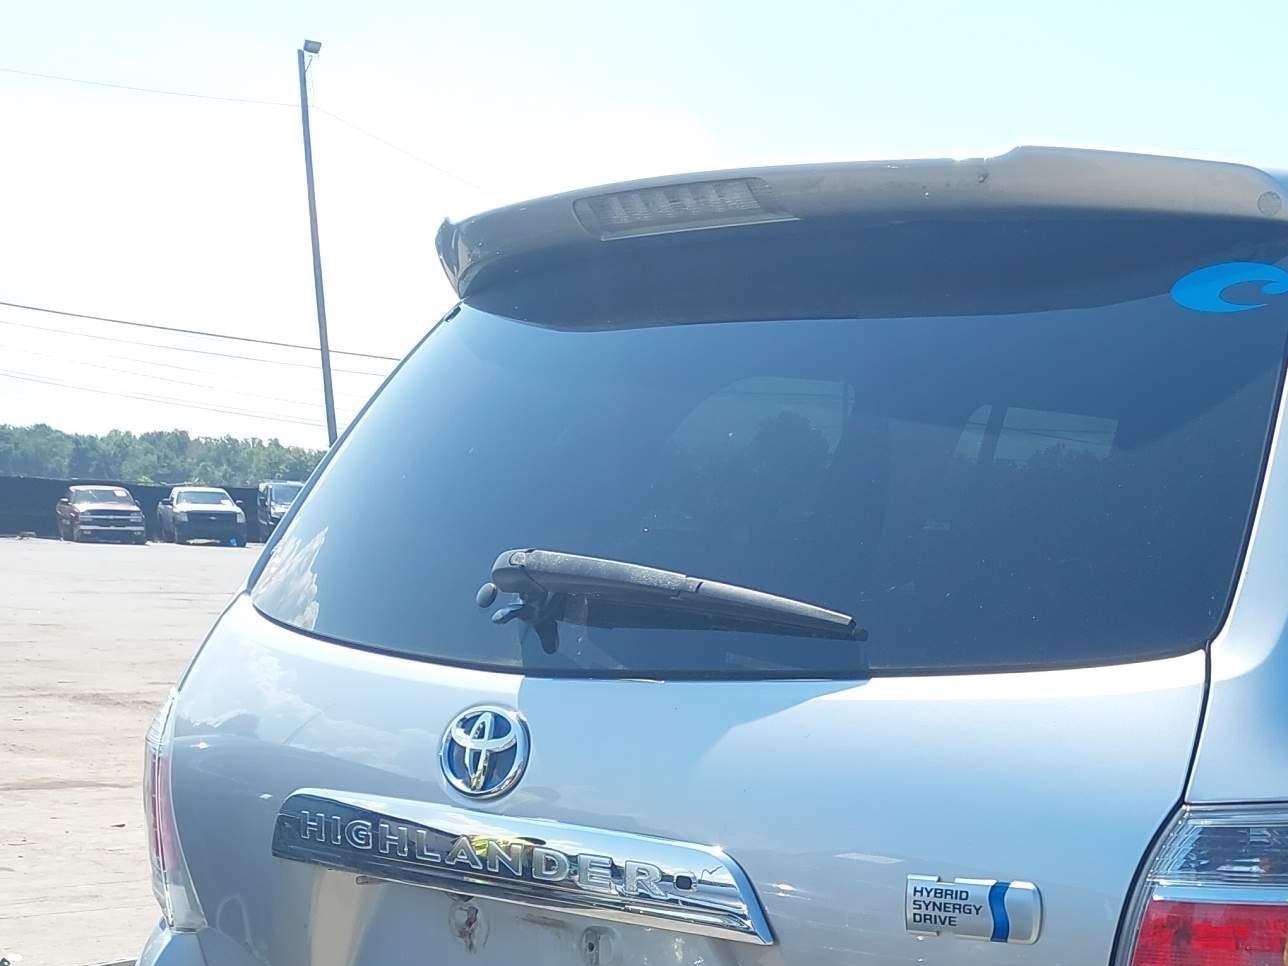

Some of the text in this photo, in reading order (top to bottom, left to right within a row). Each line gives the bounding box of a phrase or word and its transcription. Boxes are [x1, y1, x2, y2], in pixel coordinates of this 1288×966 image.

[302, 810, 669, 900] HIGHLANDER
[913, 886, 969, 901] HYBRID
[912, 900, 983, 915] SYNERGY
[912, 913, 957, 927] DRIVE
